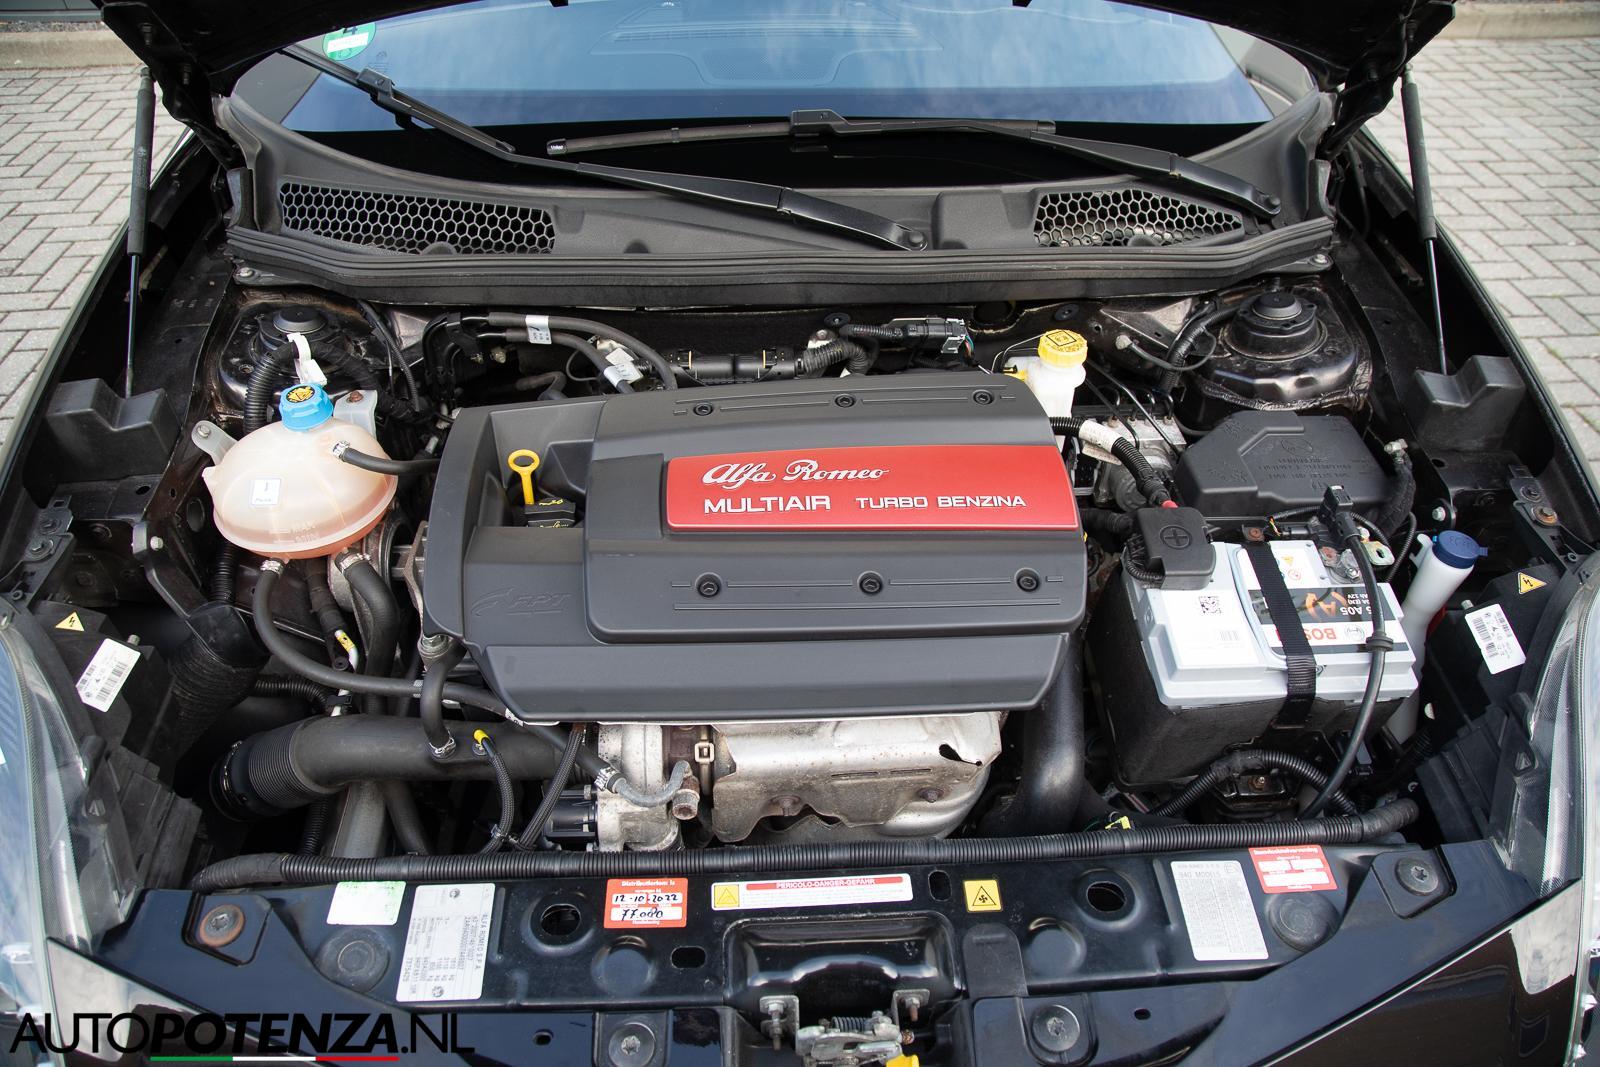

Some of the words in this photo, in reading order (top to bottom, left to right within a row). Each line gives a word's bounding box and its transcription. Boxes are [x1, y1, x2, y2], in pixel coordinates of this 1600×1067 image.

[701, 463, 777, 490] Alfa
[783, 458, 889, 482] Romeo
[703, 495, 831, 514] MULTIAIR
[855, 495, 929, 509] TURBO
[937, 495, 1027, 508] BENZINA
